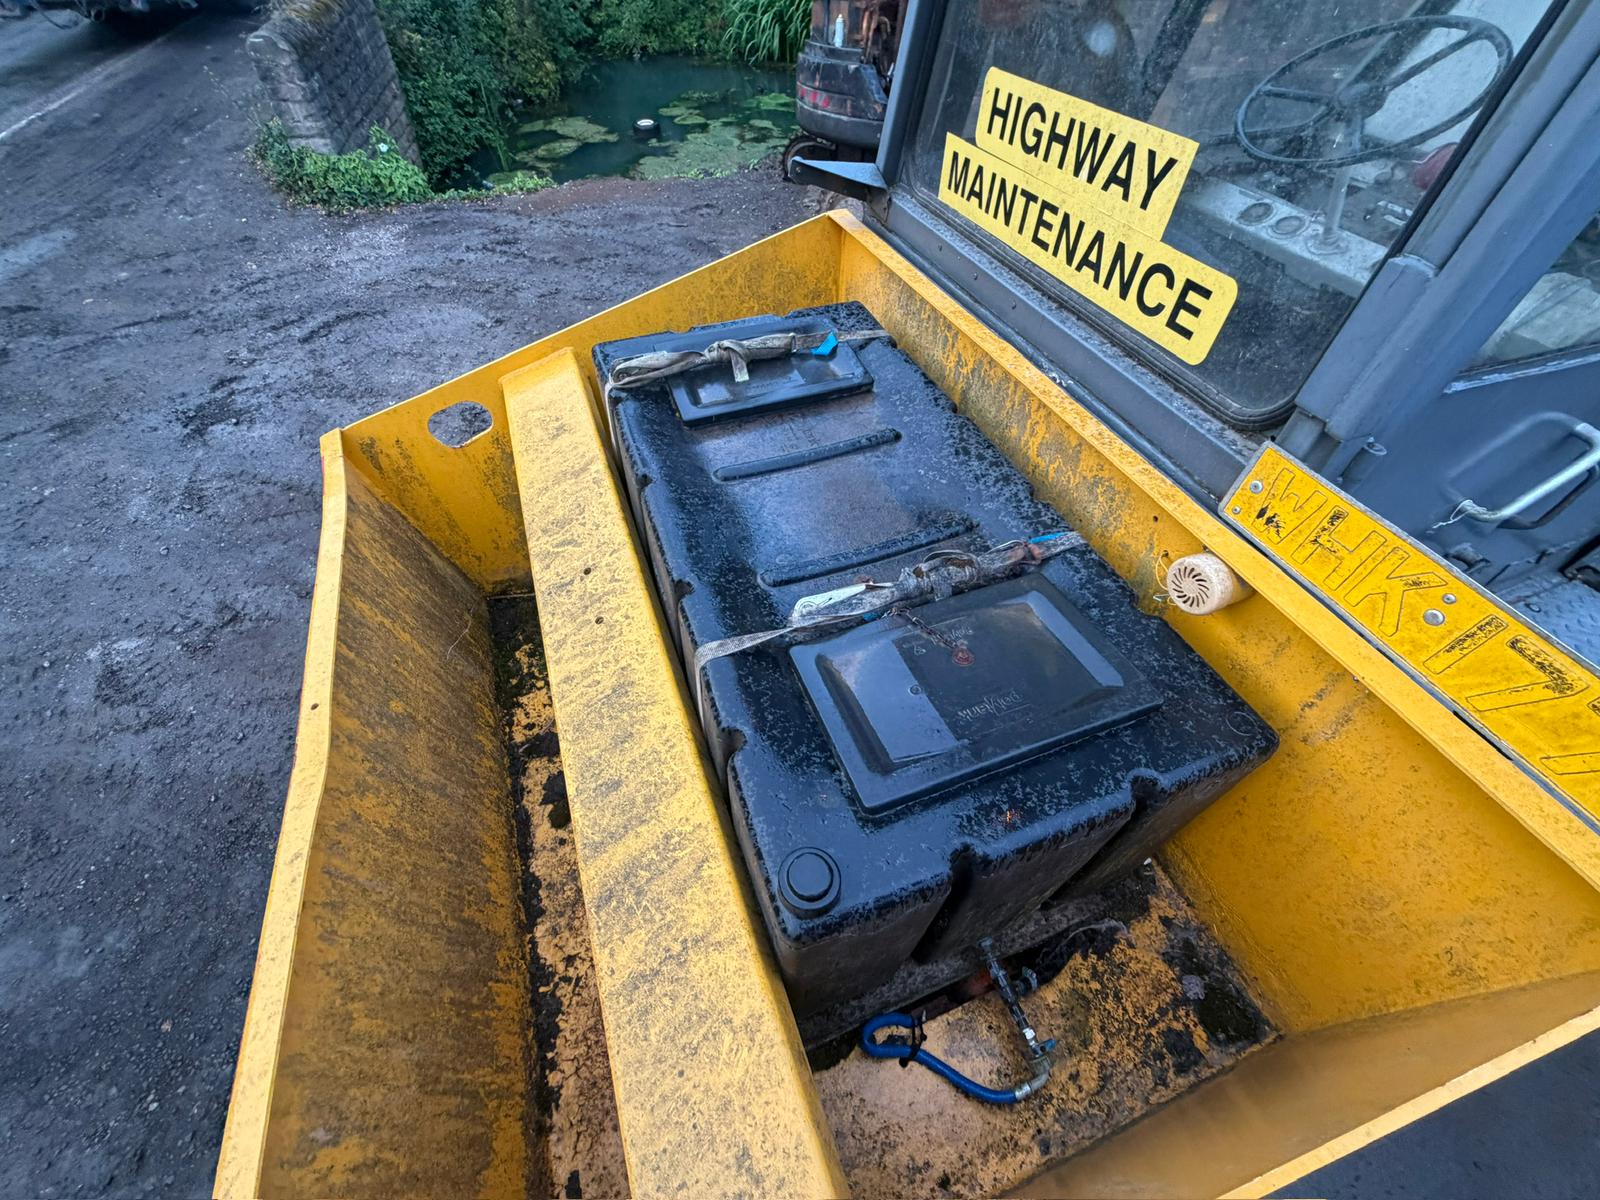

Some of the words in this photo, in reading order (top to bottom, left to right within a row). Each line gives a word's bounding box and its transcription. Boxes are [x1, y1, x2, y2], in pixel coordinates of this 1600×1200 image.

[986, 87, 1178, 211] HIGHWAY
[948, 151, 1212, 340] MAINTENANCE
[1255, 468, 1448, 637] WHK
